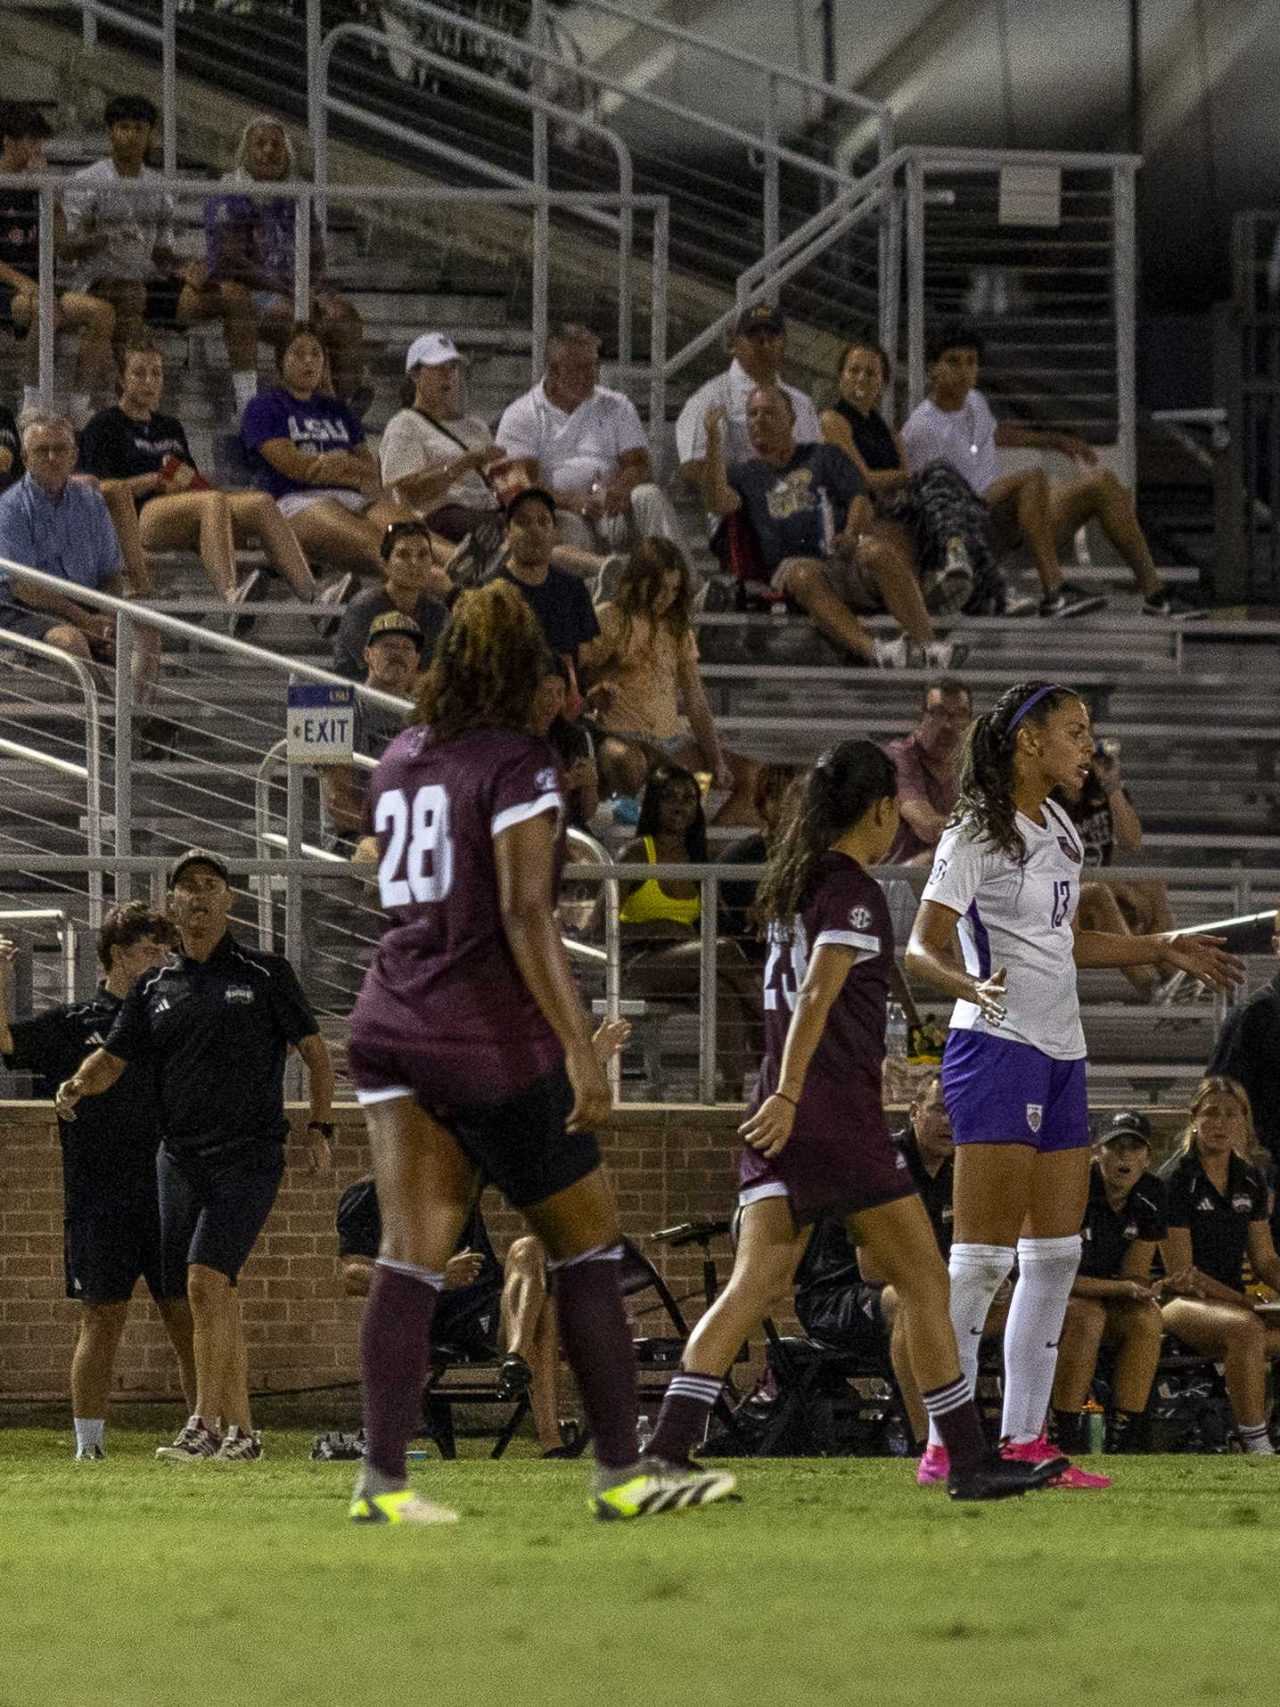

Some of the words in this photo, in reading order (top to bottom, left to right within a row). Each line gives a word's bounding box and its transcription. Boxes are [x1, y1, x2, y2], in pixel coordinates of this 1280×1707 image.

[287, 415, 350, 442] LSU
[304, 719, 349, 743] EXIT
[374, 784, 454, 909] 28
[1051, 880, 1071, 929] 13
